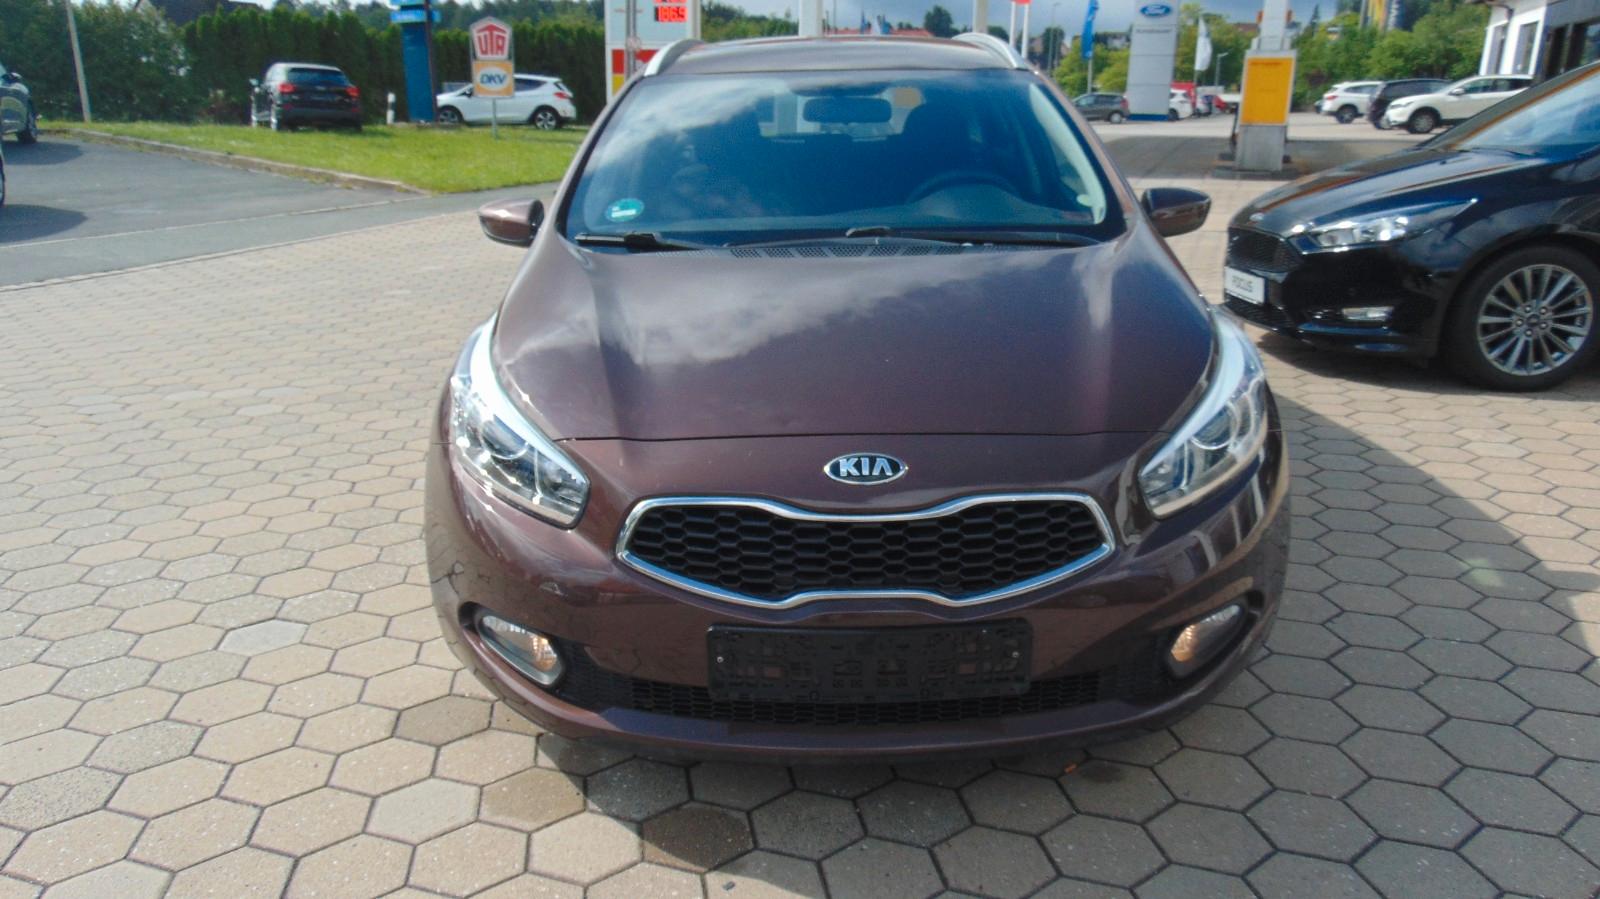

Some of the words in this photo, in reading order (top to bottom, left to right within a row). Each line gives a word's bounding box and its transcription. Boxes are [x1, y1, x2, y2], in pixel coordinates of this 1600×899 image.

[476, 24, 507, 56] UTA
[480, 73, 507, 85] DKV
[839, 457, 893, 476] KIA
